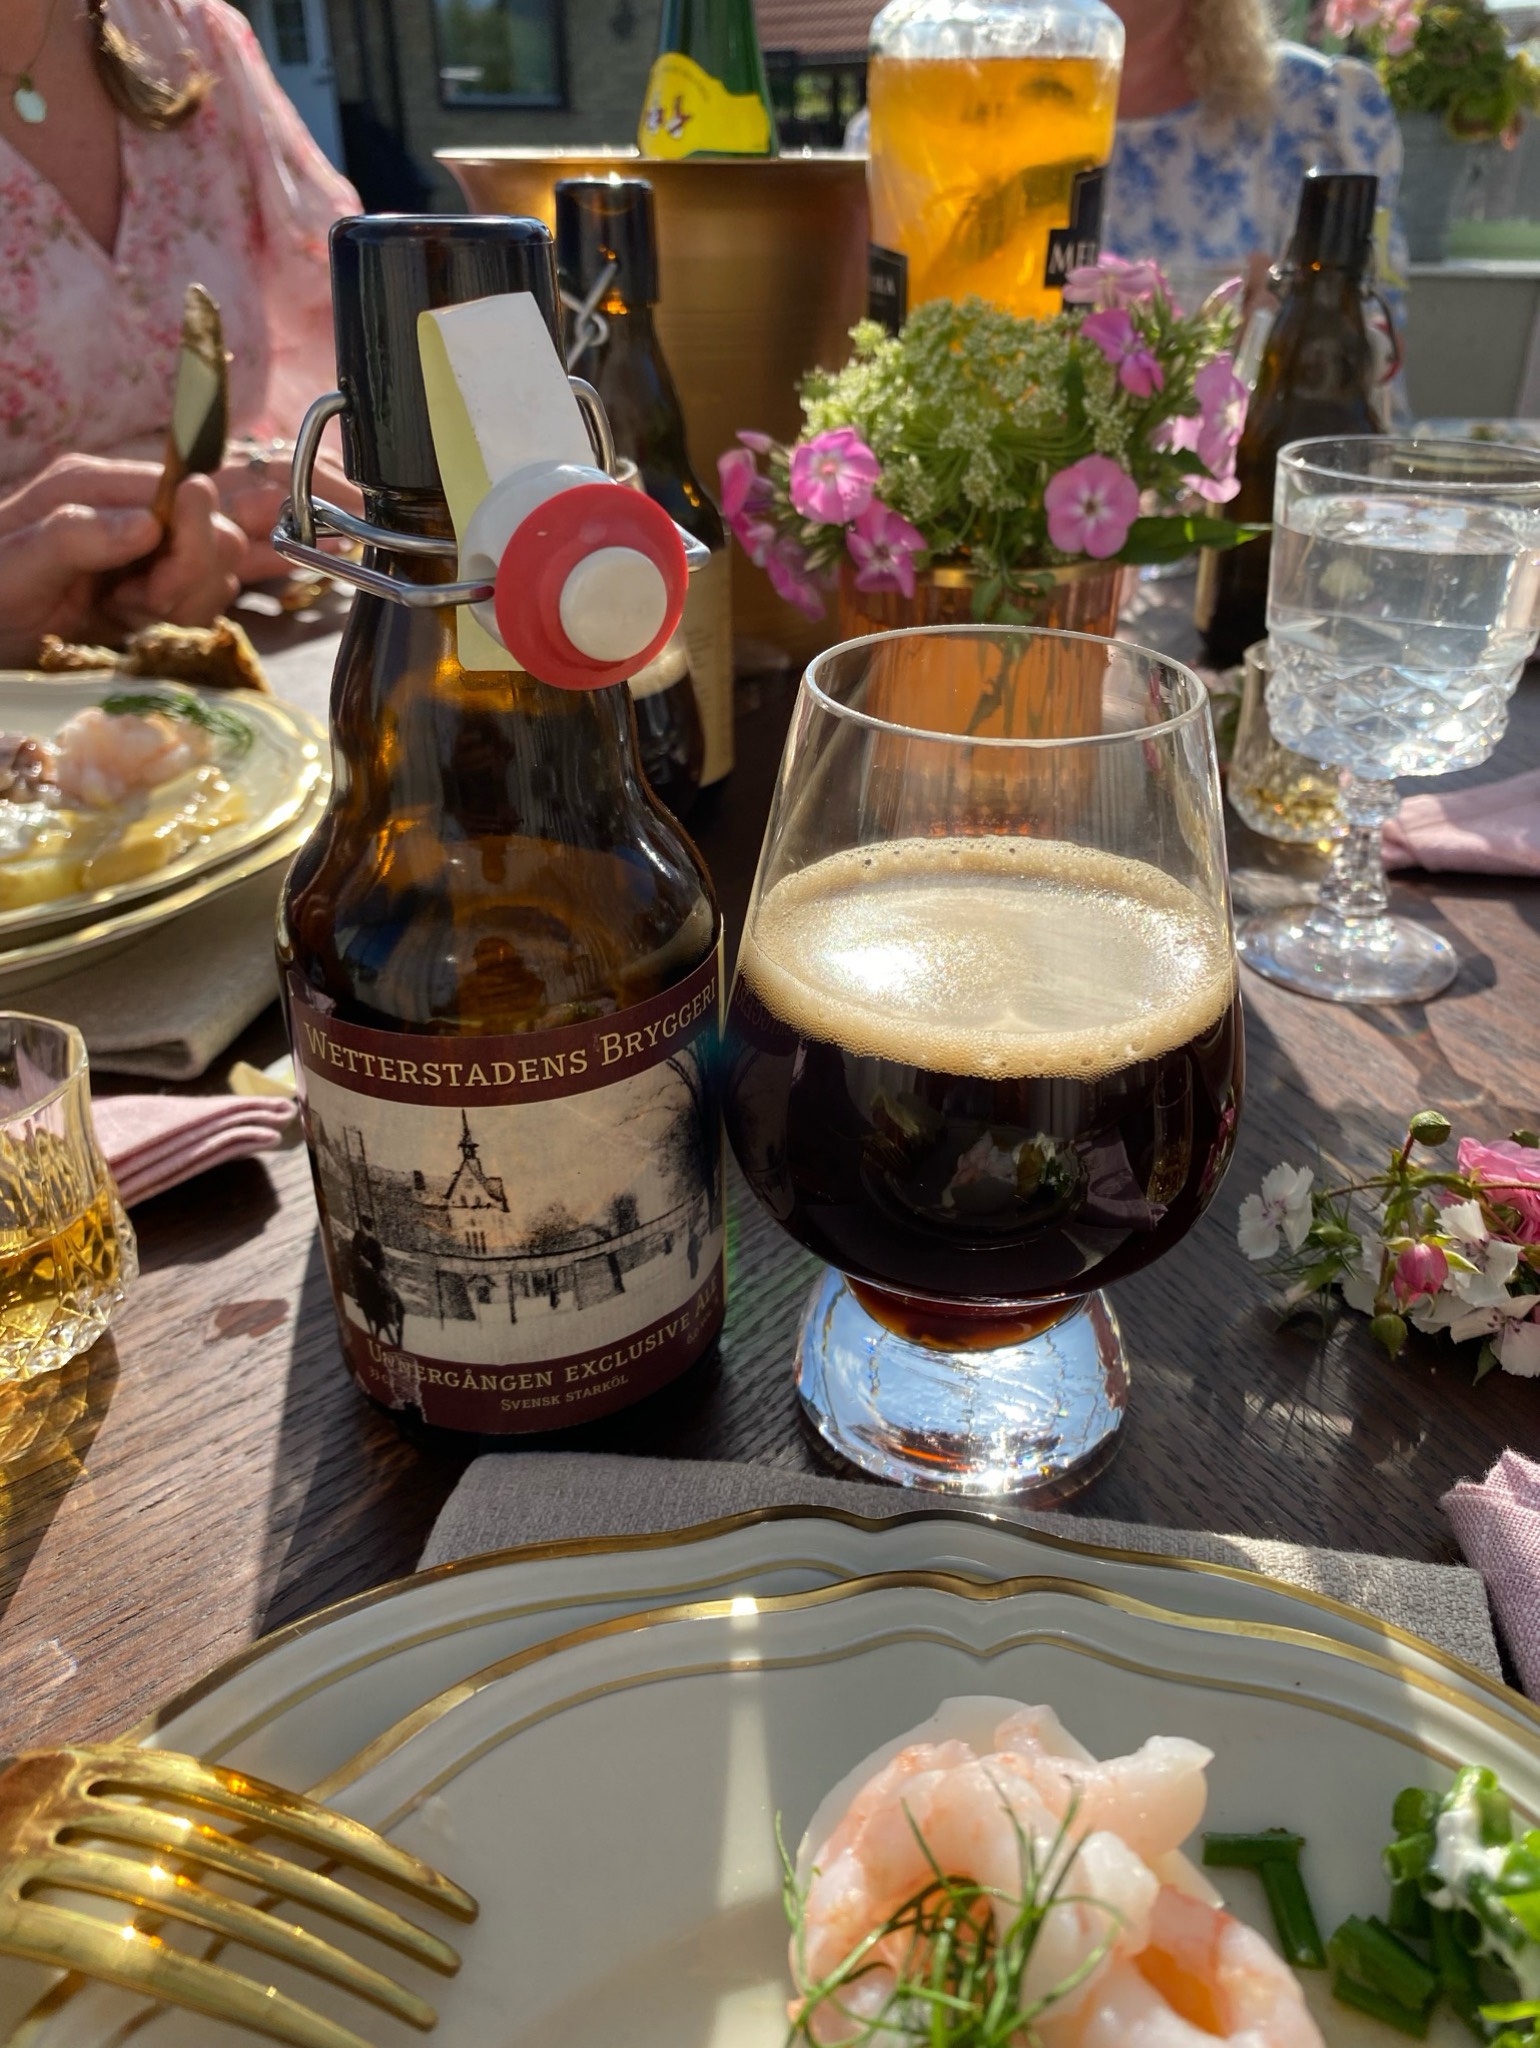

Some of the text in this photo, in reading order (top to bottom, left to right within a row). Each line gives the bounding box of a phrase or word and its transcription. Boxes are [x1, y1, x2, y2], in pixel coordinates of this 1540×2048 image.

[303, 976, 716, 1088] WETTERSTADENS BRYGGERI
[564, 1311, 691, 1383] EXCLUSIVE
[501, 1374, 630, 1412] SVENSK STARKÖL
